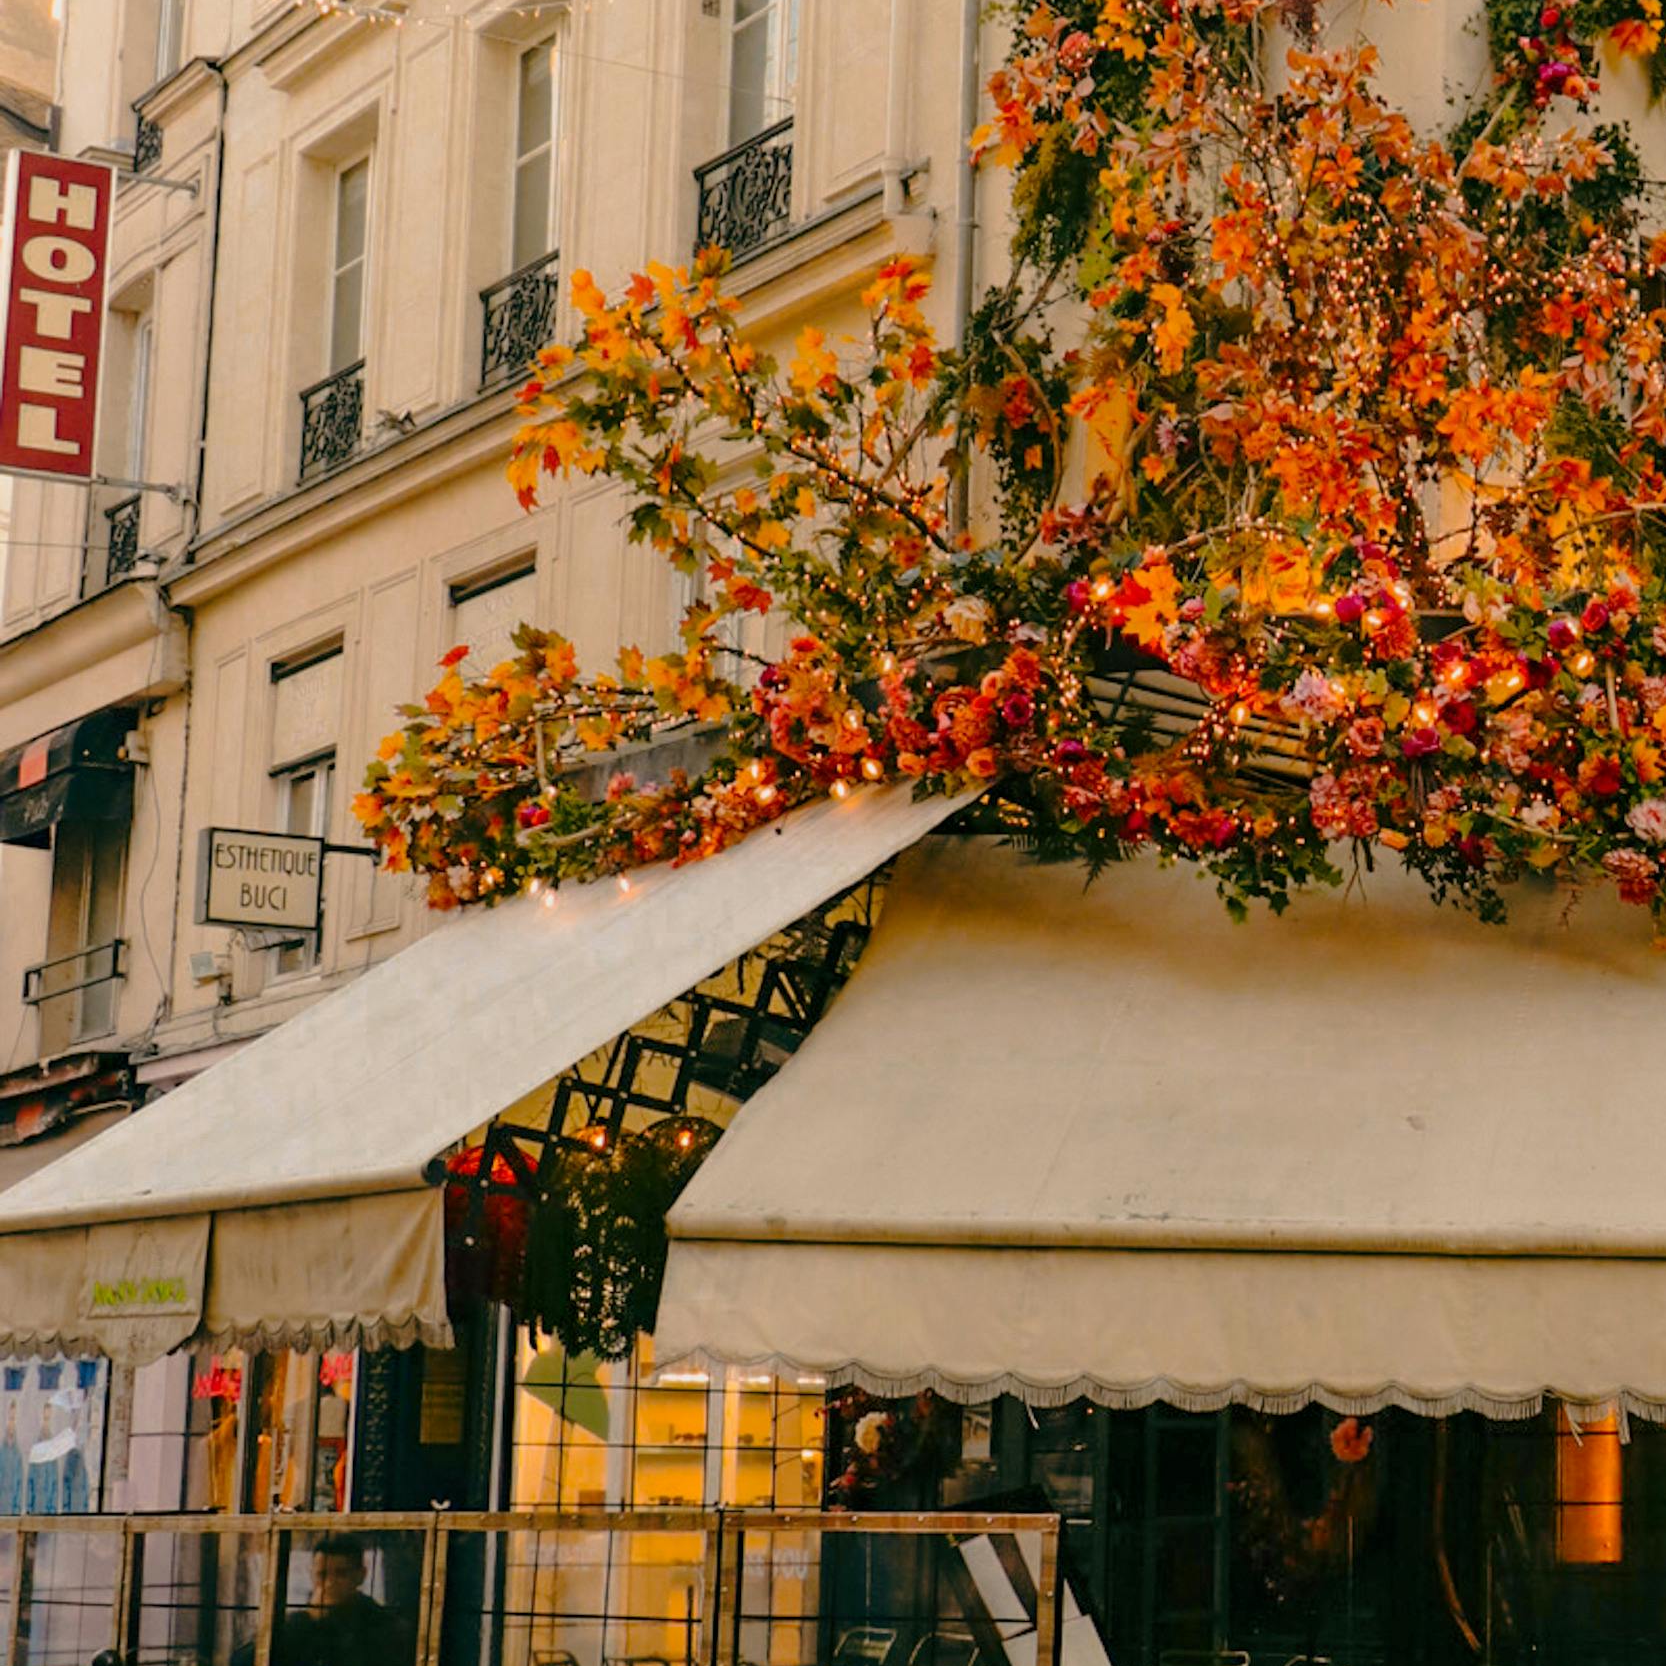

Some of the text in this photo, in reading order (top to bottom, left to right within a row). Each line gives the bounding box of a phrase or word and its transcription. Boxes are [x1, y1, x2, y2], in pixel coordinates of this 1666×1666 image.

[17, 175, 98, 456] HOTEL
[214, 842, 318, 878] ESTHETIQUE
[240, 882, 288, 911] BUCI
